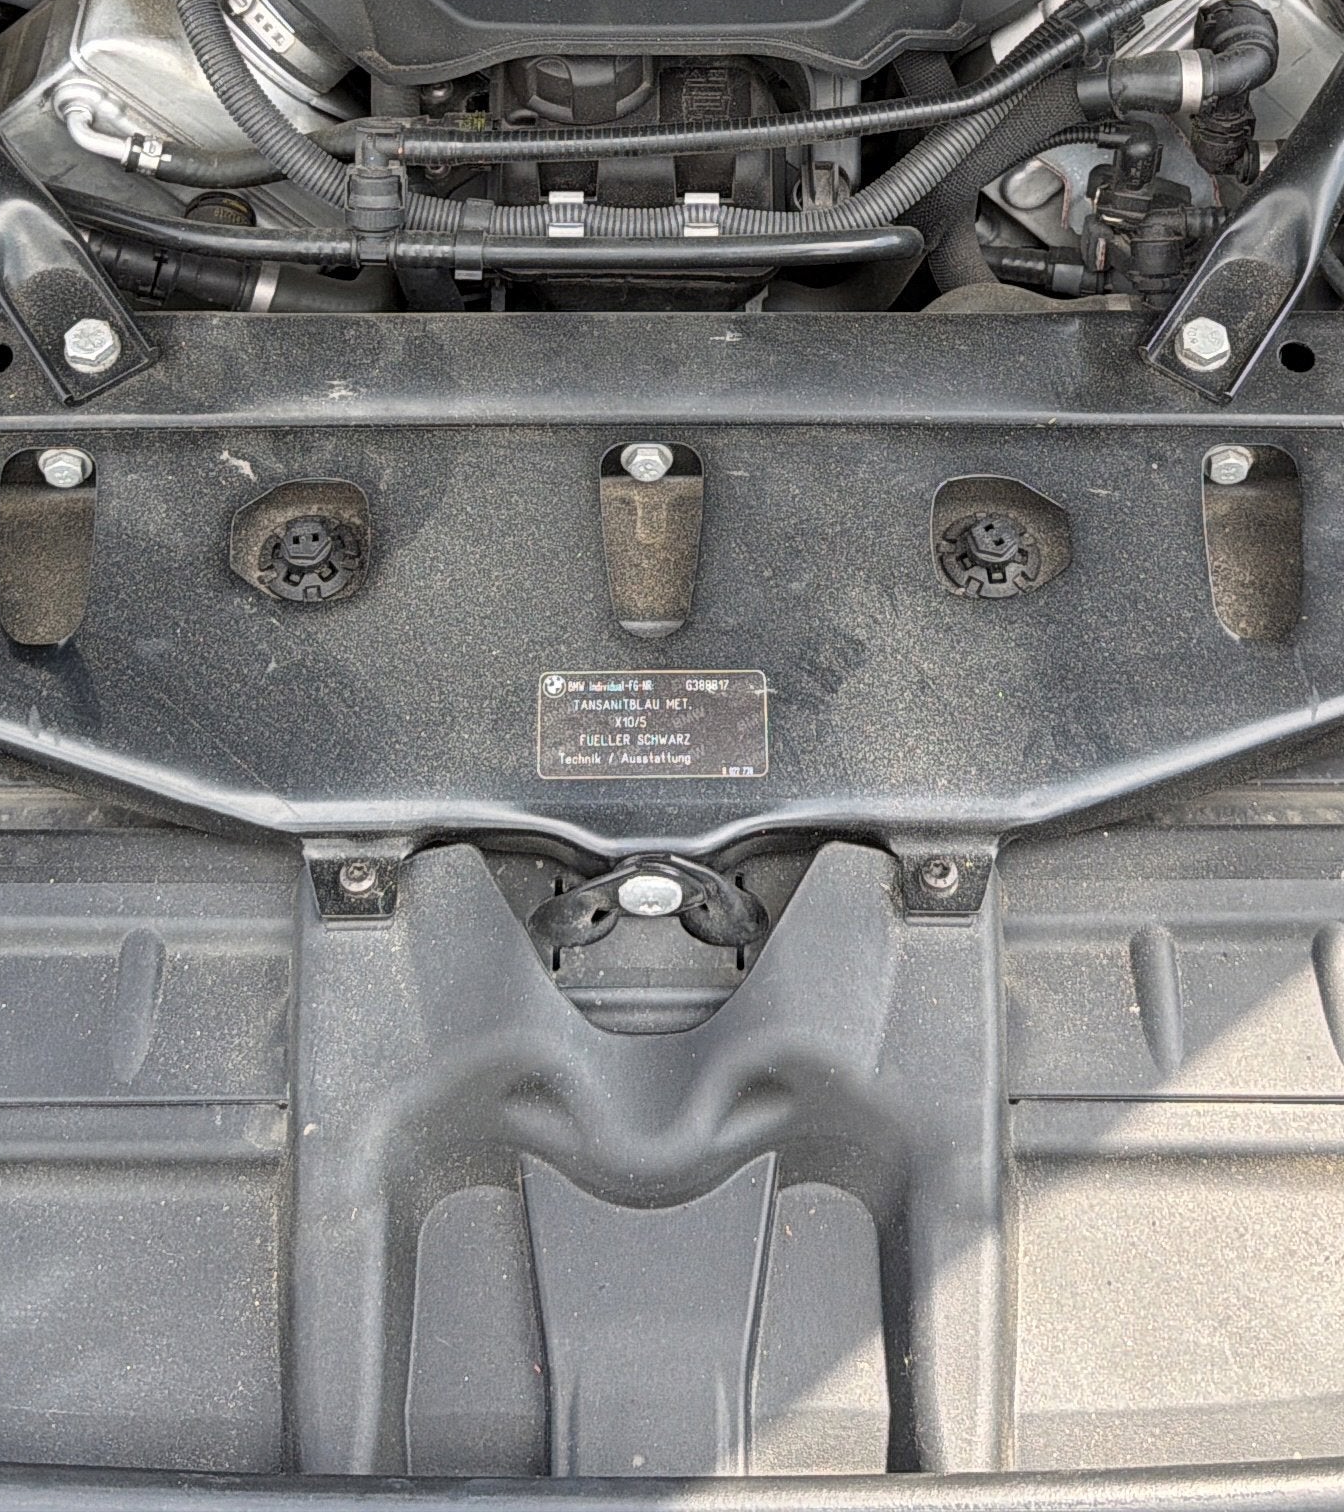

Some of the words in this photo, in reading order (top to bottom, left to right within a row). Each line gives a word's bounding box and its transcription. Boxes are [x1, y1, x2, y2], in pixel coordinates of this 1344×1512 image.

[574, 698, 660, 711] TANSANITBLAU
[666, 697, 693, 710] MET.
[615, 716, 647, 728] X10/5
[580, 734, 631, 746] FUELLER
[637, 734, 691, 746] SCHWARZ
[560, 752, 601, 764] Technik
[621, 752, 692, 765] Ausstattung
